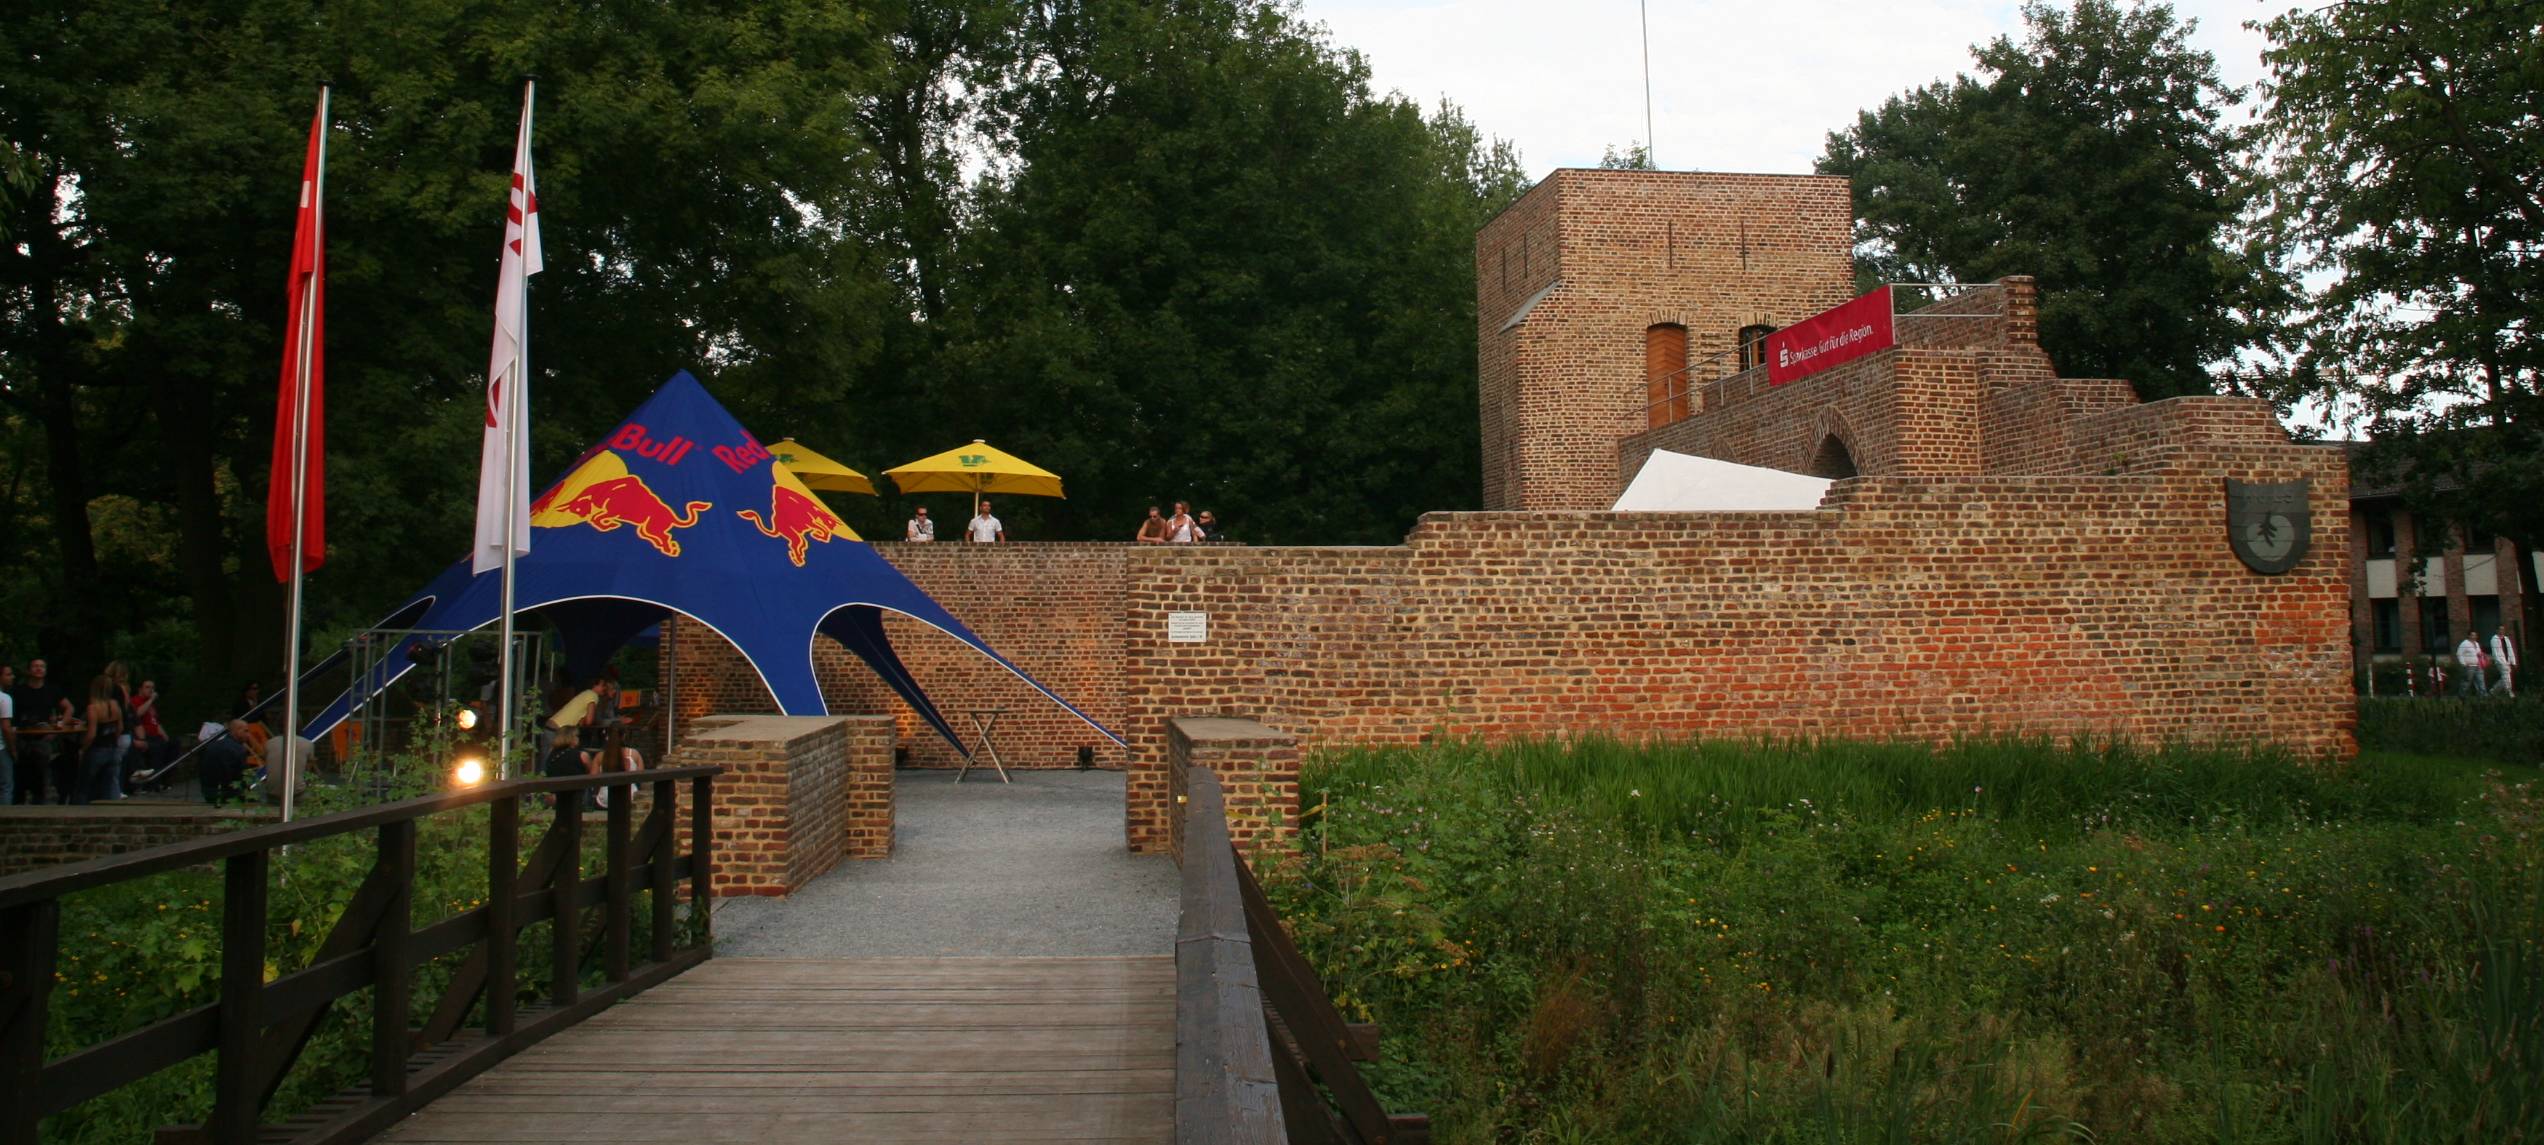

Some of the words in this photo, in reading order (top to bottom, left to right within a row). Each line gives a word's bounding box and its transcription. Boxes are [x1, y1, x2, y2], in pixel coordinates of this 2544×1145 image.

[1818, 339, 1829, 354] Gut
[1829, 335, 1839, 350] für
[1839, 331, 1849, 346] die
[608, 422, 694, 466] Bull
[711, 429, 771, 475] Red
